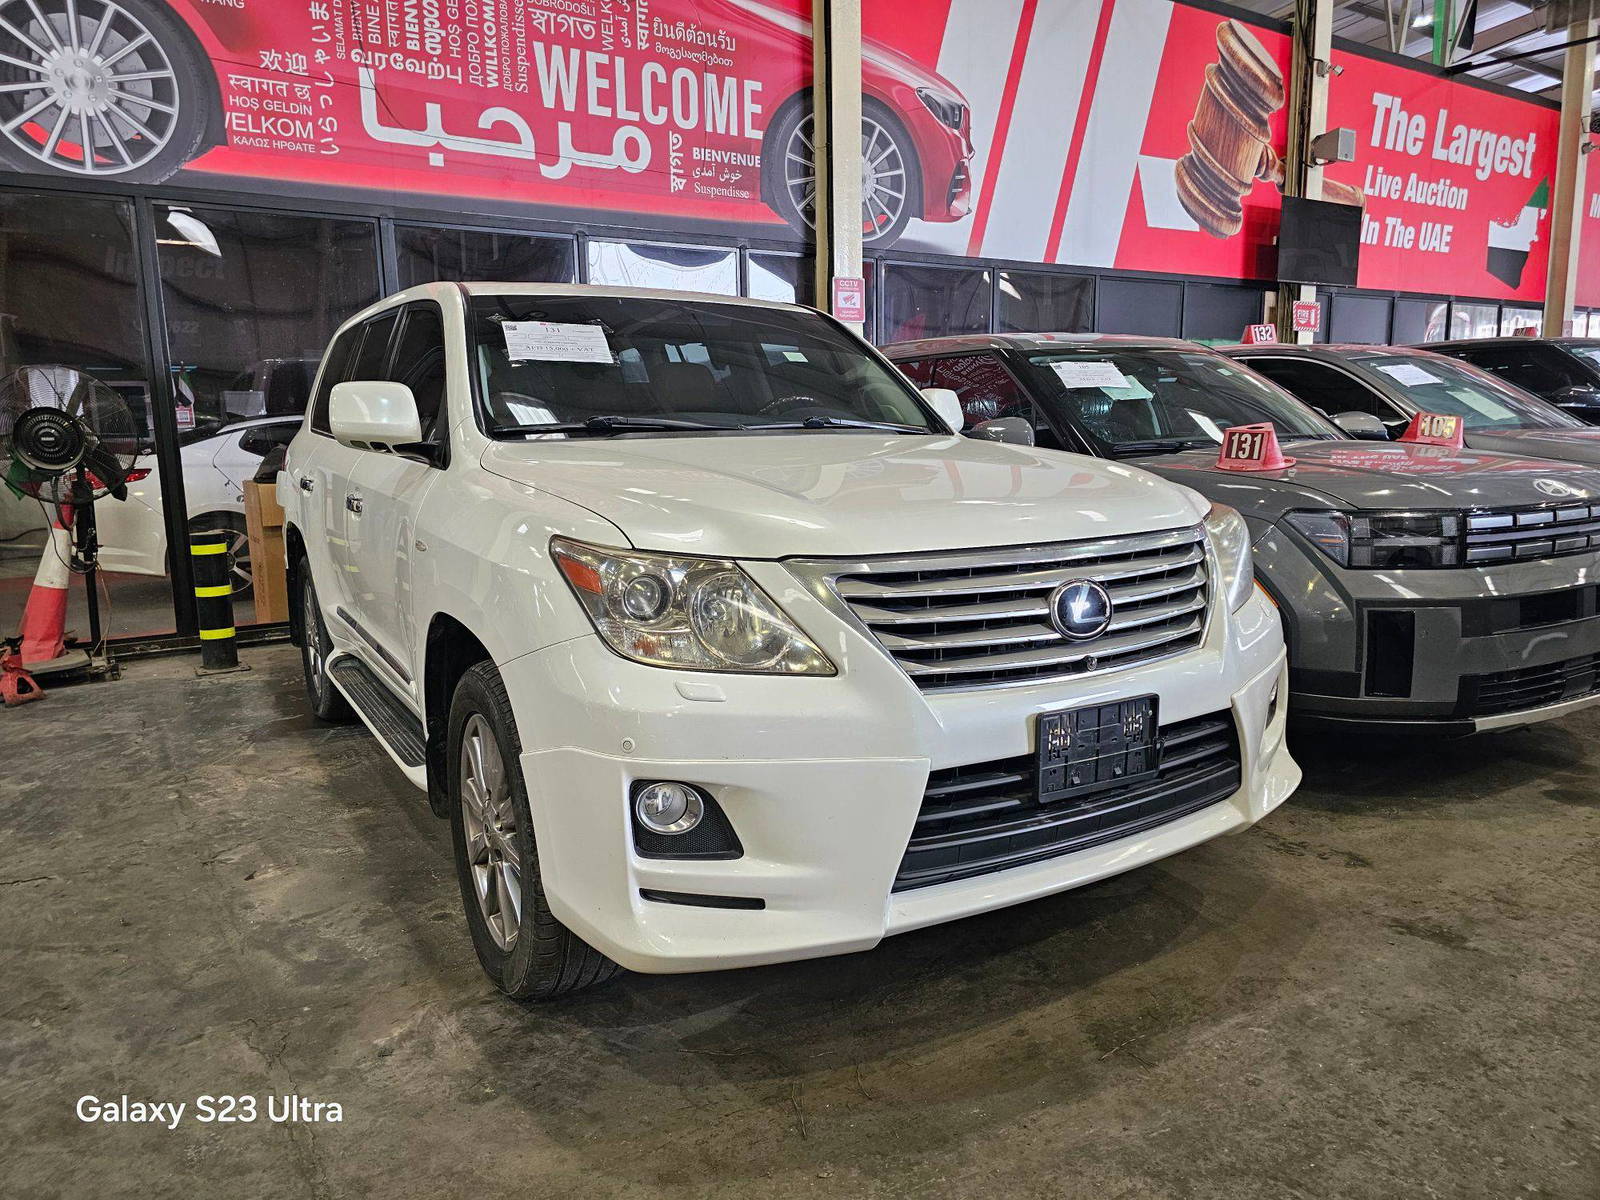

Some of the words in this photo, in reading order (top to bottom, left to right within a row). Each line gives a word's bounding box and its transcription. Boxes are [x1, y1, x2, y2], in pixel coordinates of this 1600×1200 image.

[333, 9, 346, 60] SELAMAT
[366, 4, 382, 44] BINE
[259, 48, 309, 76] 欢迎
[466, 31, 485, 87] ДОБРО
[502, 56, 514, 92] ДОБРО
[229, 95, 260, 111] HOŞ
[532, 40, 764, 140] WELCOME
[359, 66, 652, 180] مرحبا
[1370, 92, 1426, 156] The
[1431, 108, 1537, 182] Largest
[692, 146, 761, 168] BIENVENUE
[694, 181, 751, 199] Suspendisse
[1363, 164, 1401, 202] Live
[1403, 172, 1469, 211] Auction
[1360, 213, 1380, 246] In
[1384, 216, 1417, 250] The
[1418, 221, 1453, 253] UAE
[1253, 325, 1273, 342] 132
[1230, 431, 1263, 461] 131
